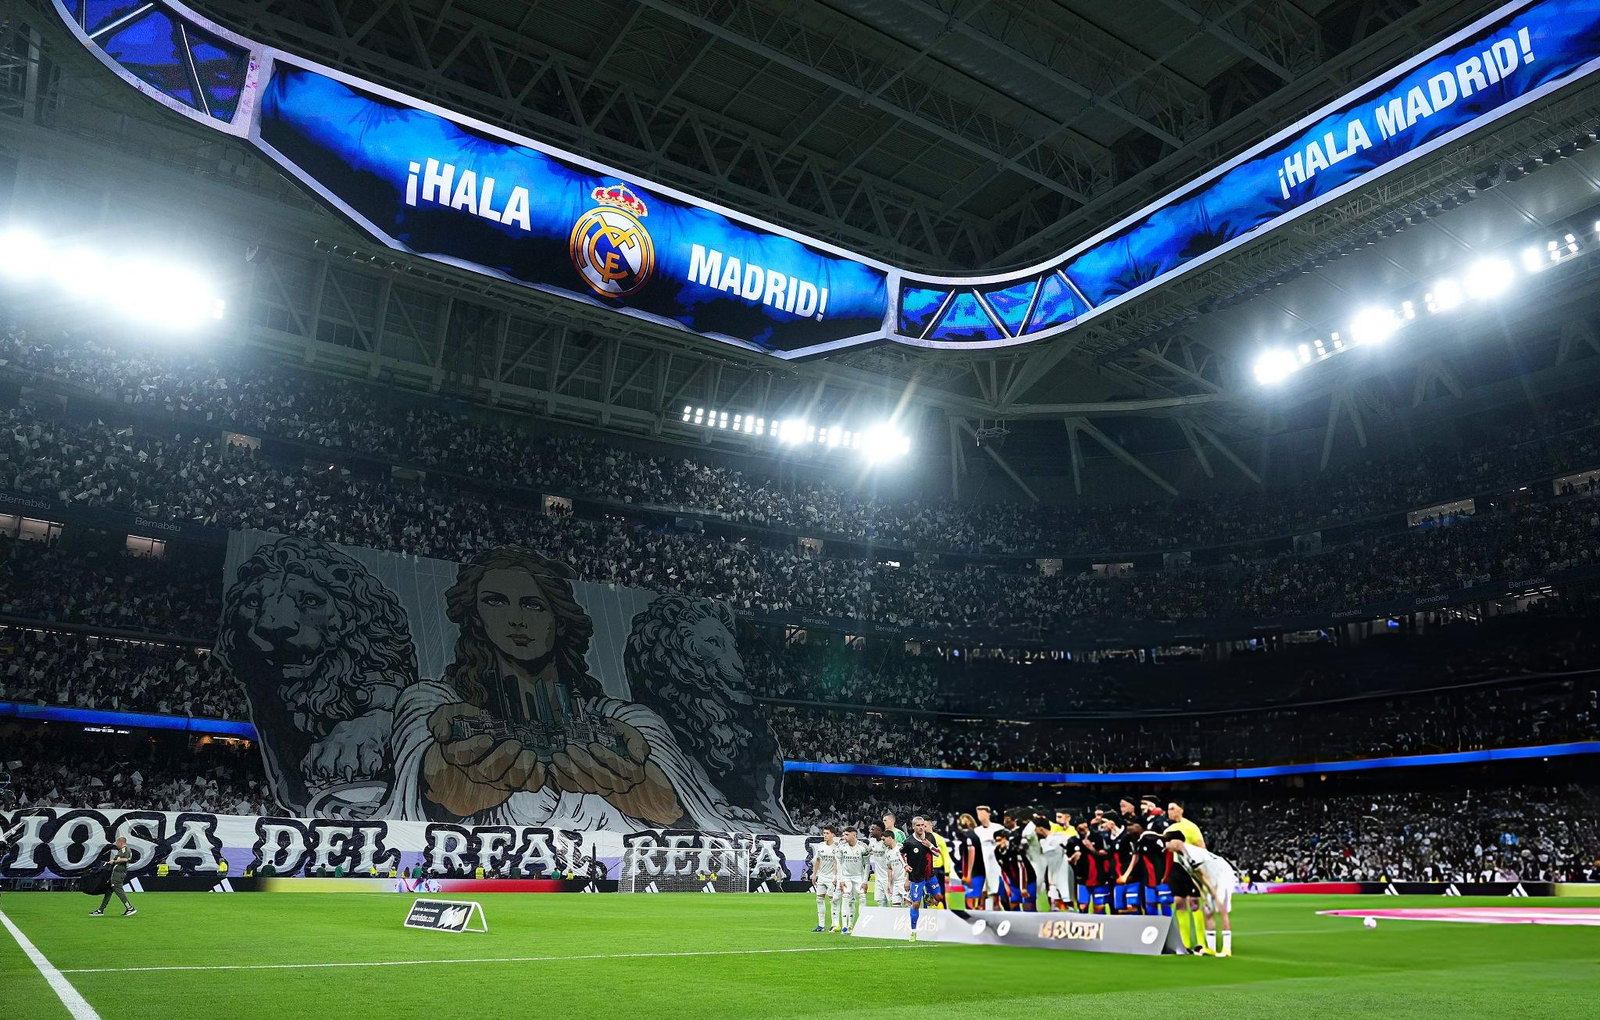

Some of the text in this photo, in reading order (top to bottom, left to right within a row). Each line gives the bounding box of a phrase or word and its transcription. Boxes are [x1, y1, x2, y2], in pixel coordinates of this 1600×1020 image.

[1278, 26, 1535, 200] ¡HALA MADRID!
[405, 157, 828, 323] ¡HALA MADRID!
[0, 492, 51, 510] Bernabéu
[135, 516, 181, 532] Bernabéu
[258, 819, 400, 876] DEL
[425, 825, 603, 878] REAL
